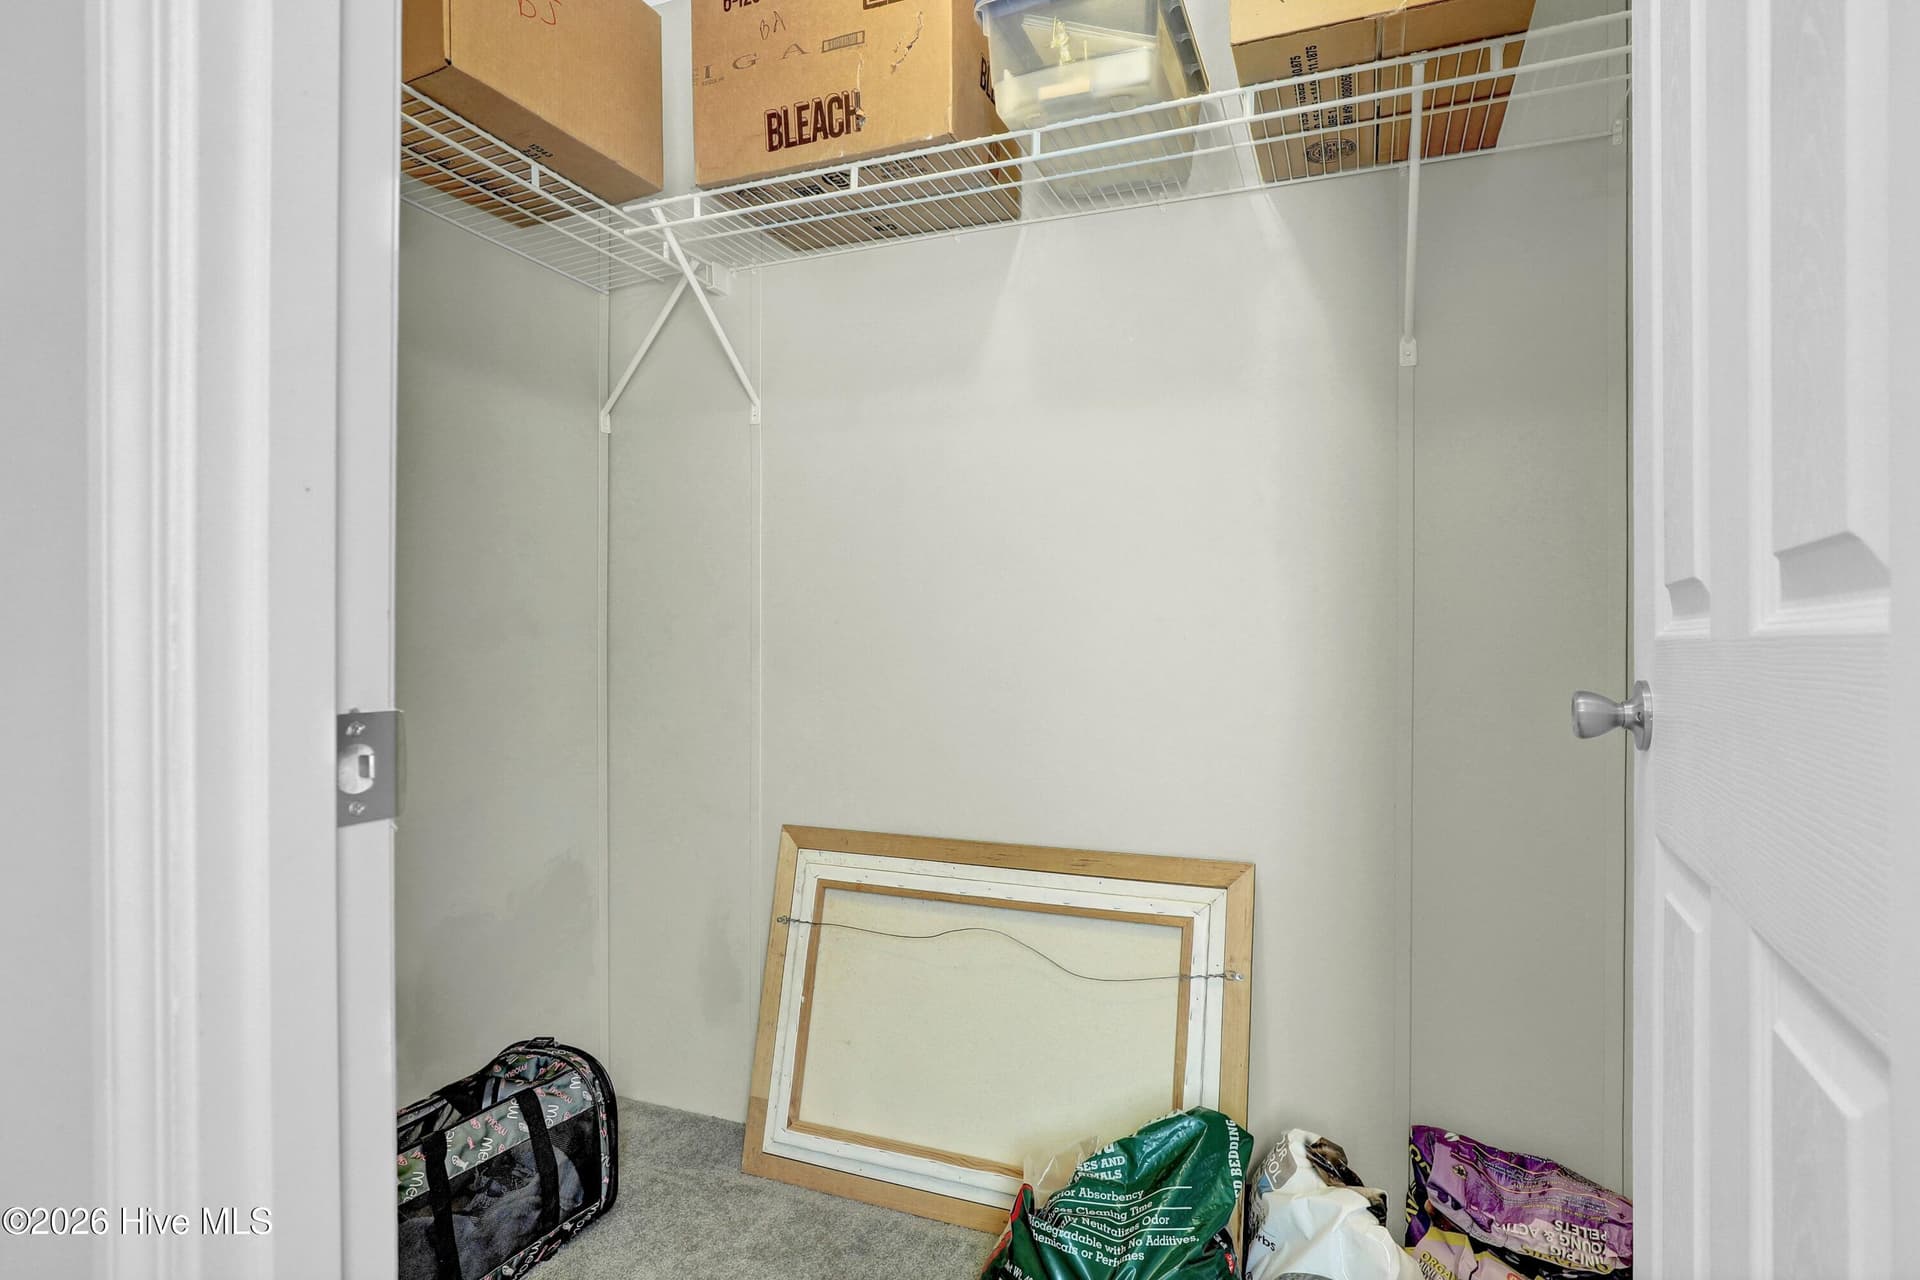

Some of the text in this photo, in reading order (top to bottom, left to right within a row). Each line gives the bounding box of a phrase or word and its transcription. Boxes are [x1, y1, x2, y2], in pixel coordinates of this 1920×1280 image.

[763, 88, 862, 153] BLEACH
[1226, 1119, 1243, 1177] BEDDING
[1101, 1155, 1126, 1170] AND
[1079, 1187, 1144, 1202] Absorbency
[1076, 1206, 1128, 1222] Cleaning
[1129, 1201, 1153, 1217] Time
[1081, 1216, 1140, 1238] Neutralizes
[1142, 1213, 1170, 1226] Odor
[1554, 1219, 1608, 1242] PELLETS
[1081, 1249, 1094, 1260] or
[1104, 1244, 1127, 1256] with
[1128, 1237, 1143, 1249] No
[1145, 1234, 1200, 1247] Additives.
